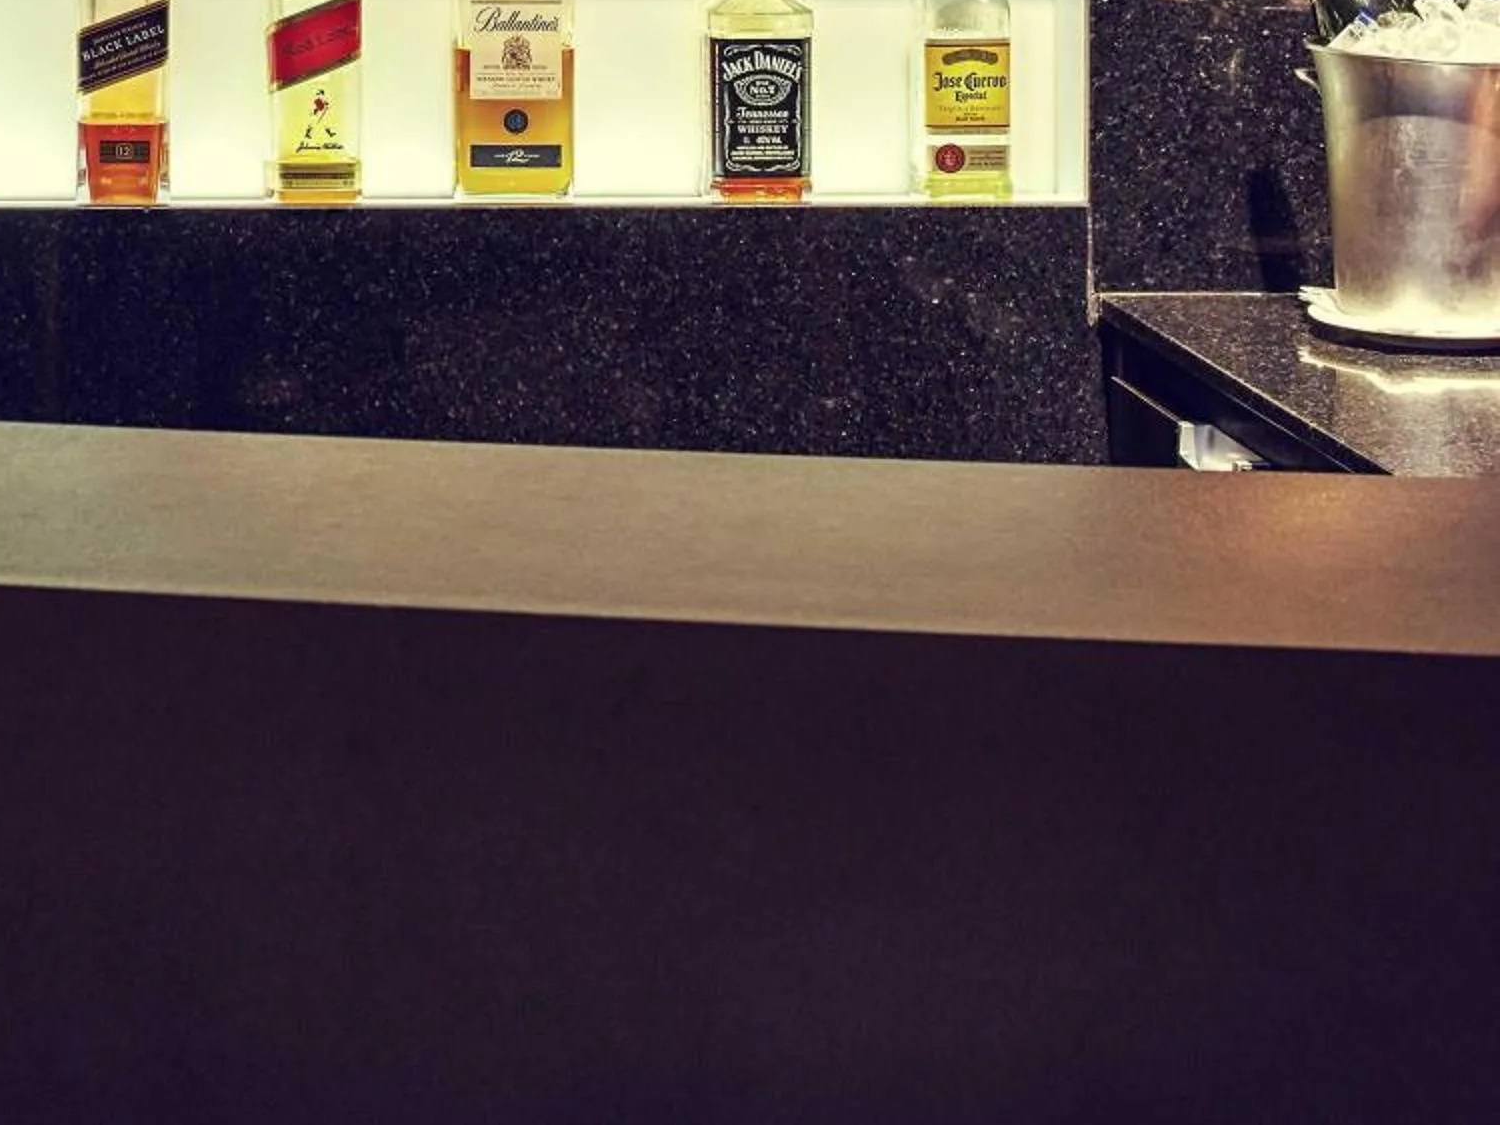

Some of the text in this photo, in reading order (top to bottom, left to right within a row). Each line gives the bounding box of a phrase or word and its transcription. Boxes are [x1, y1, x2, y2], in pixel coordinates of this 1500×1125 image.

[473, 6, 560, 32] Ballantine's
[82, 41, 123, 62] BLACK
[125, 23, 165, 47] LABEL
[721, 55, 754, 82] JACK
[933, 72, 1009, 92] Jose Cuervo
